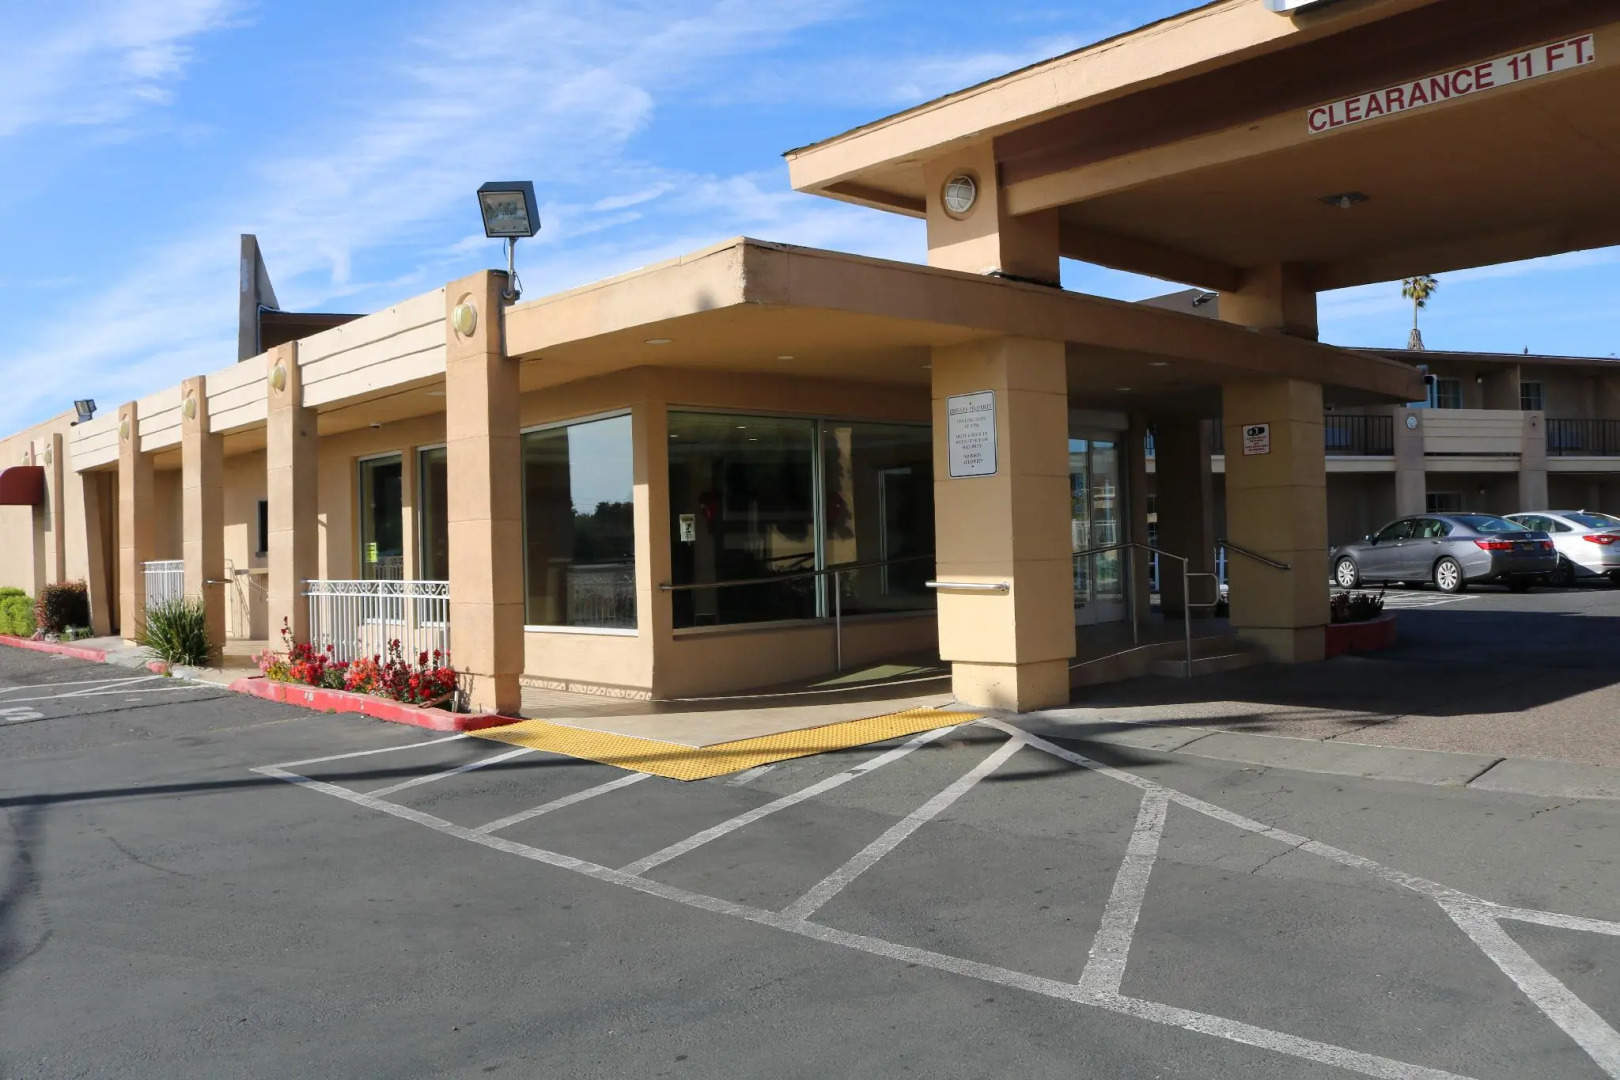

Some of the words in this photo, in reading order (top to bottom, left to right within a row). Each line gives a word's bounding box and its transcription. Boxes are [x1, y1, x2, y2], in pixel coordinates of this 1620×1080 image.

[1308, 62, 1494, 132] CLEARANCE
[1507, 53, 1533, 81] 11
[1545, 36, 1594, 72] FT.
